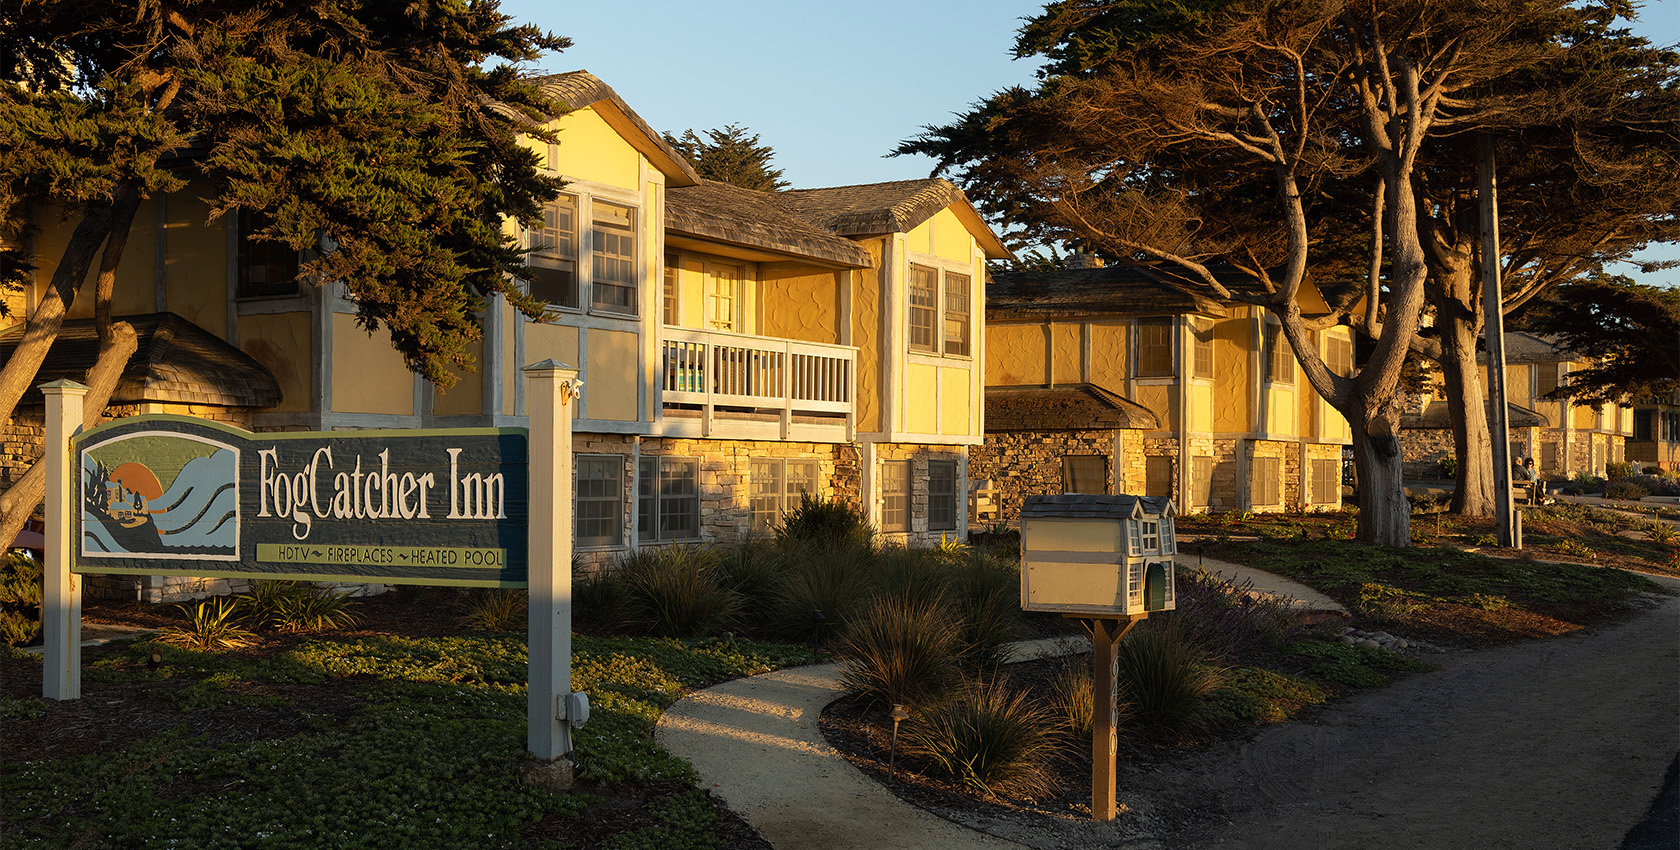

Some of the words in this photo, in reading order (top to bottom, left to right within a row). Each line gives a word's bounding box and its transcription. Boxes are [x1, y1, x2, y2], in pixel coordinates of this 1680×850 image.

[257, 445, 435, 540] FogCatcher
[446, 448, 508, 519] Inn
[278, 546, 310, 561] HDTV
[327, 548, 393, 564] FIREPLACES
[411, 548, 457, 565] HEATED
[464, 550, 503, 566] POOL
[1110, 655, 1119, 755] 6400
